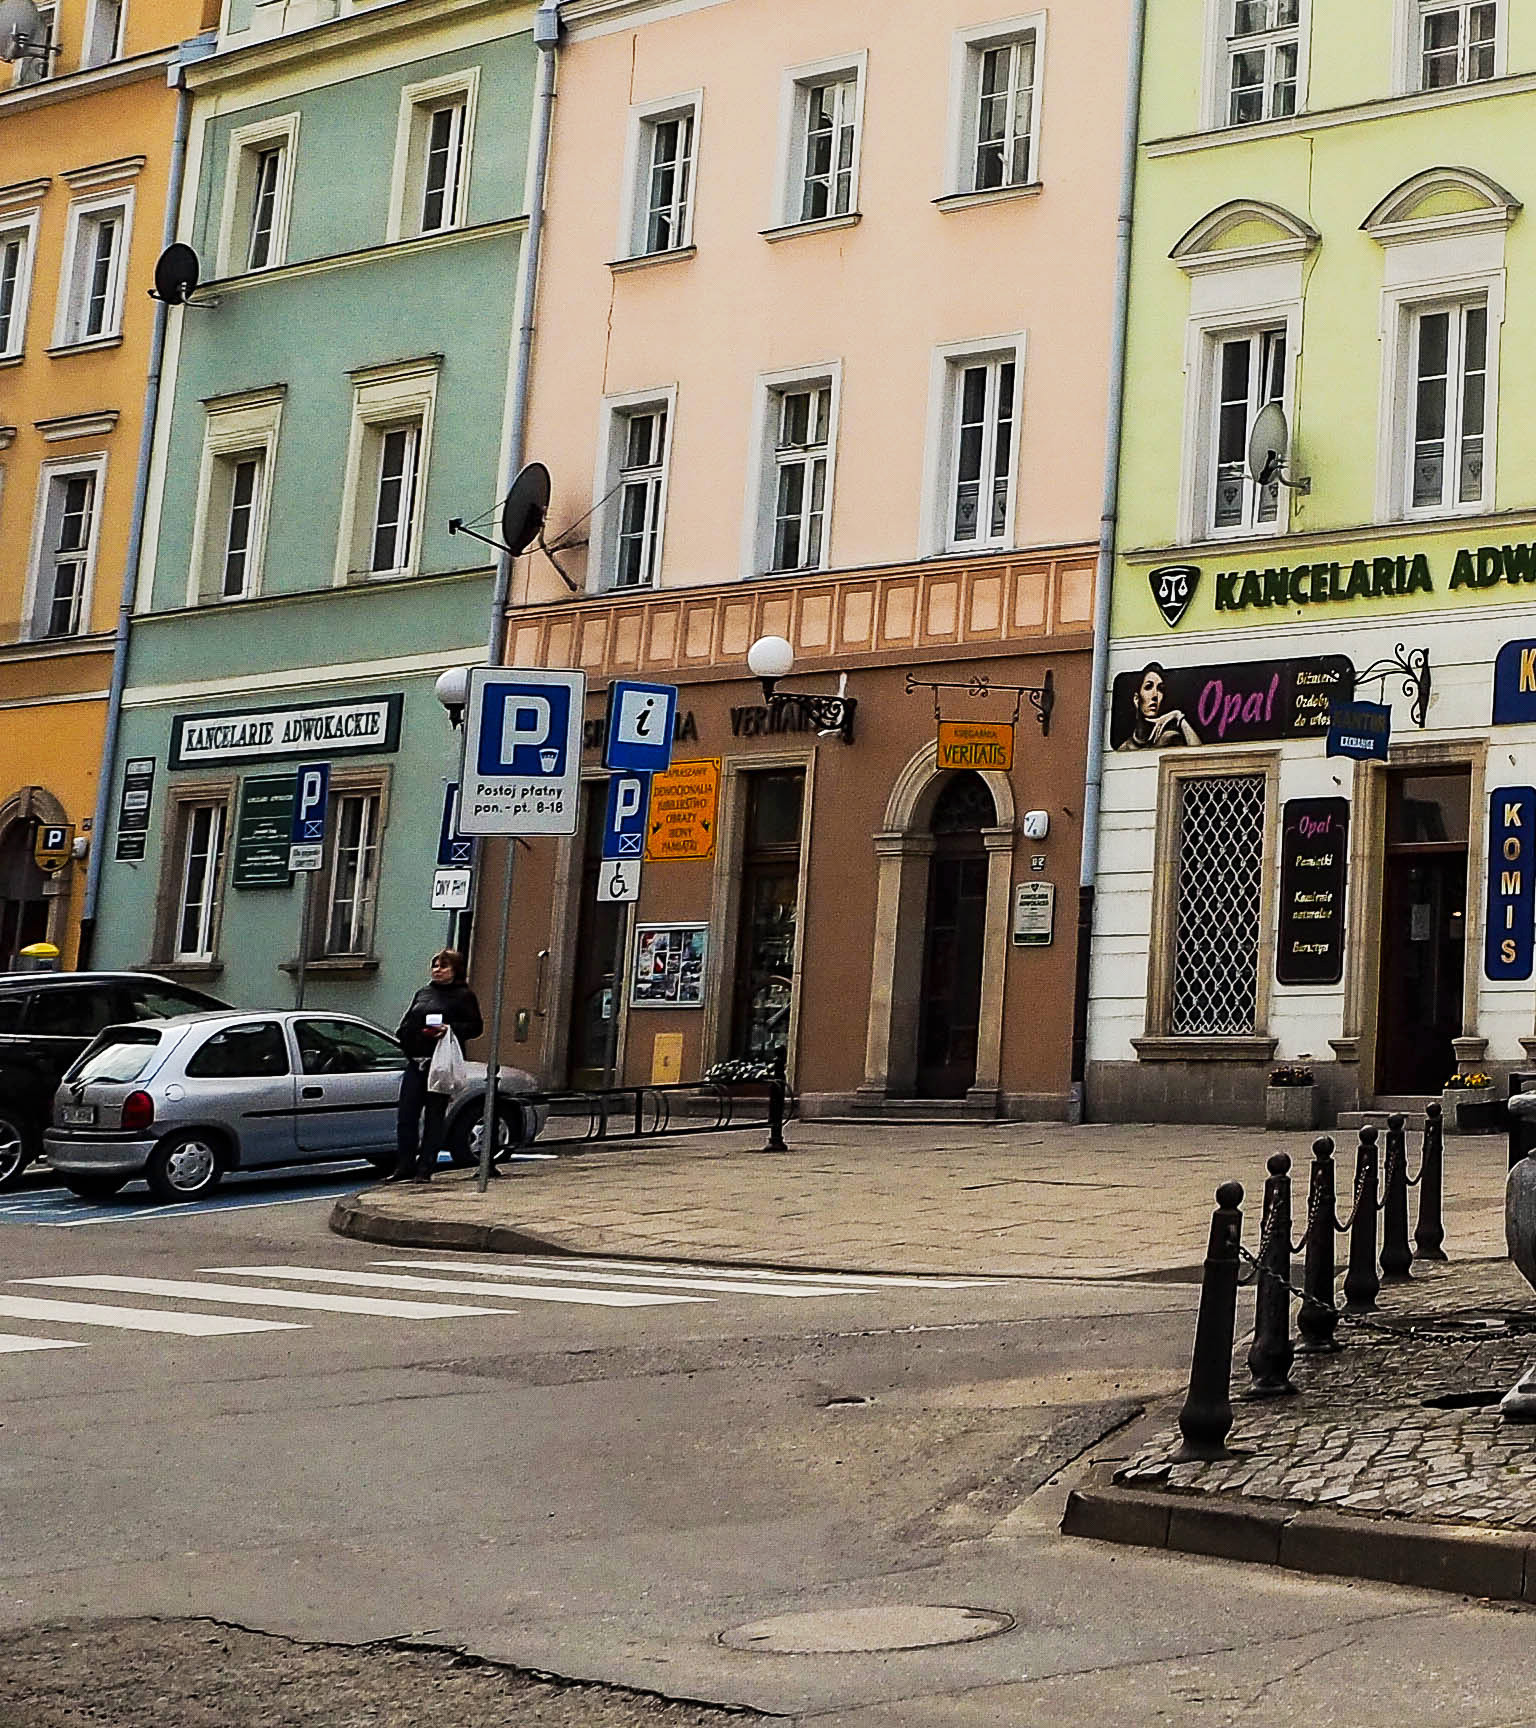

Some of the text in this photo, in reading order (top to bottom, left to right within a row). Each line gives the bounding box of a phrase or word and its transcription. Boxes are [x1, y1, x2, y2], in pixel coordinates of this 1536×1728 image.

[1214, 552, 1434, 612] KANCELARIA
[1198, 673, 1280, 738] Opal
[185, 711, 381, 752] KANCELARIE ADWOKACKIE
[500, 695, 551, 765] P
[943, 743, 1007, 764] VERITATIS
[300, 771, 321, 821] P
[477, 783, 564, 800] Postój płatny
[536, 801, 565, 814] 8-18
[614, 778, 641, 832] P
[48, 830, 62, 848] P
[1299, 815, 1332, 839] Opal
[1500, 802, 1523, 964] KOMIS
